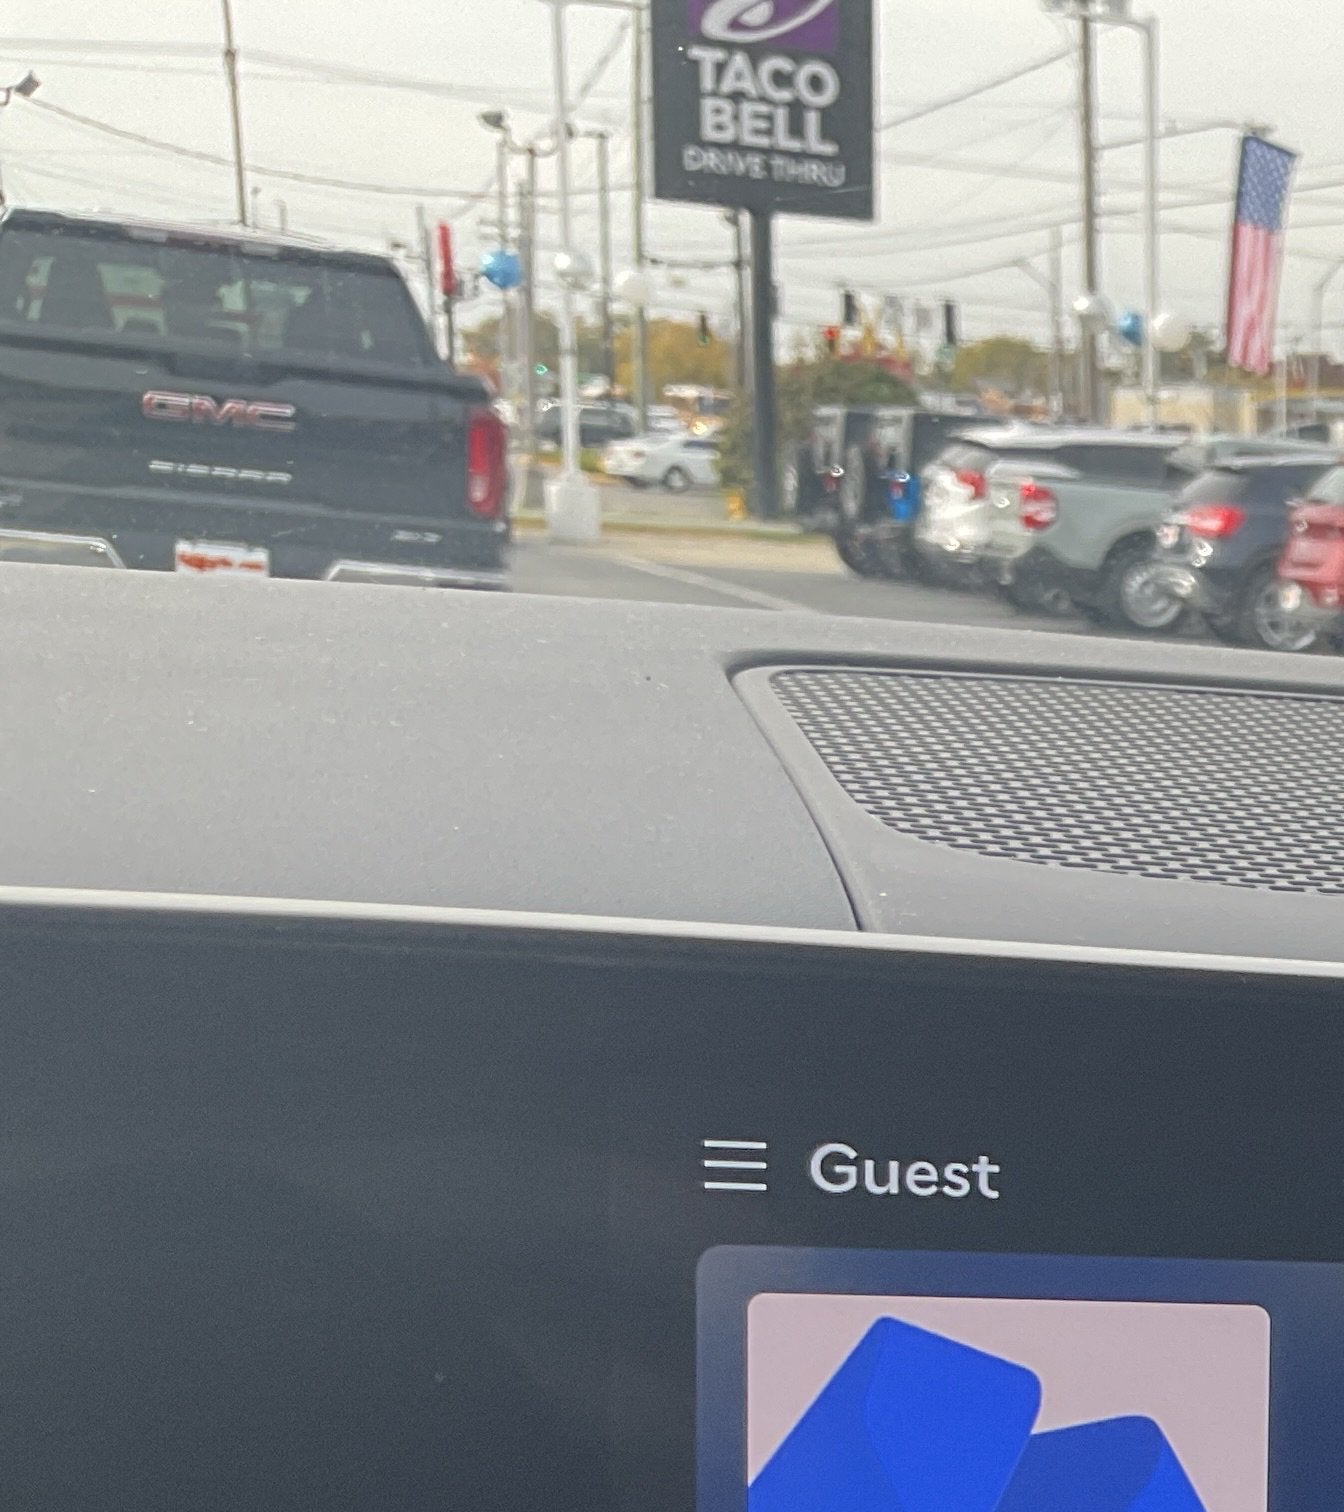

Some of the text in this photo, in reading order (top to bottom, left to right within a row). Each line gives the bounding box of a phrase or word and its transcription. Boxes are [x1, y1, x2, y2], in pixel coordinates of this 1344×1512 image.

[686, 46, 841, 109] TACO
[700, 97, 840, 157] BELL
[682, 145, 847, 188] DRIVE THRU
[142, 389, 297, 432] GMC
[808, 1141, 1002, 1200] Guest
